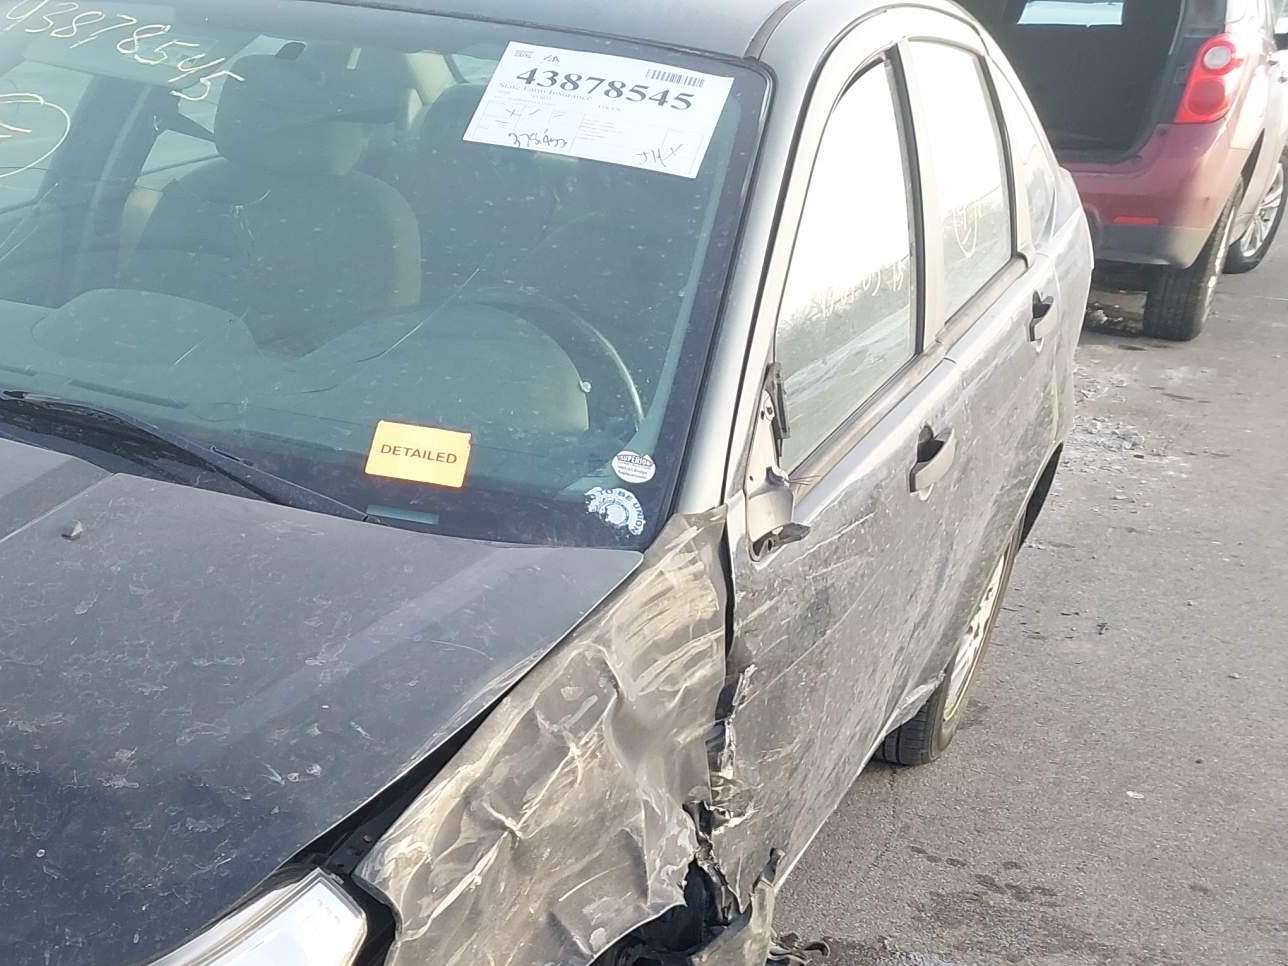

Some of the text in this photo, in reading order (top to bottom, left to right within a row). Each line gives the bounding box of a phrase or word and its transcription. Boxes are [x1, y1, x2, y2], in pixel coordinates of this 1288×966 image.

[3, 0, 245, 102] 43878545
[515, 66, 696, 112] 43878545
[380, 443, 457, 465] DETAILED
